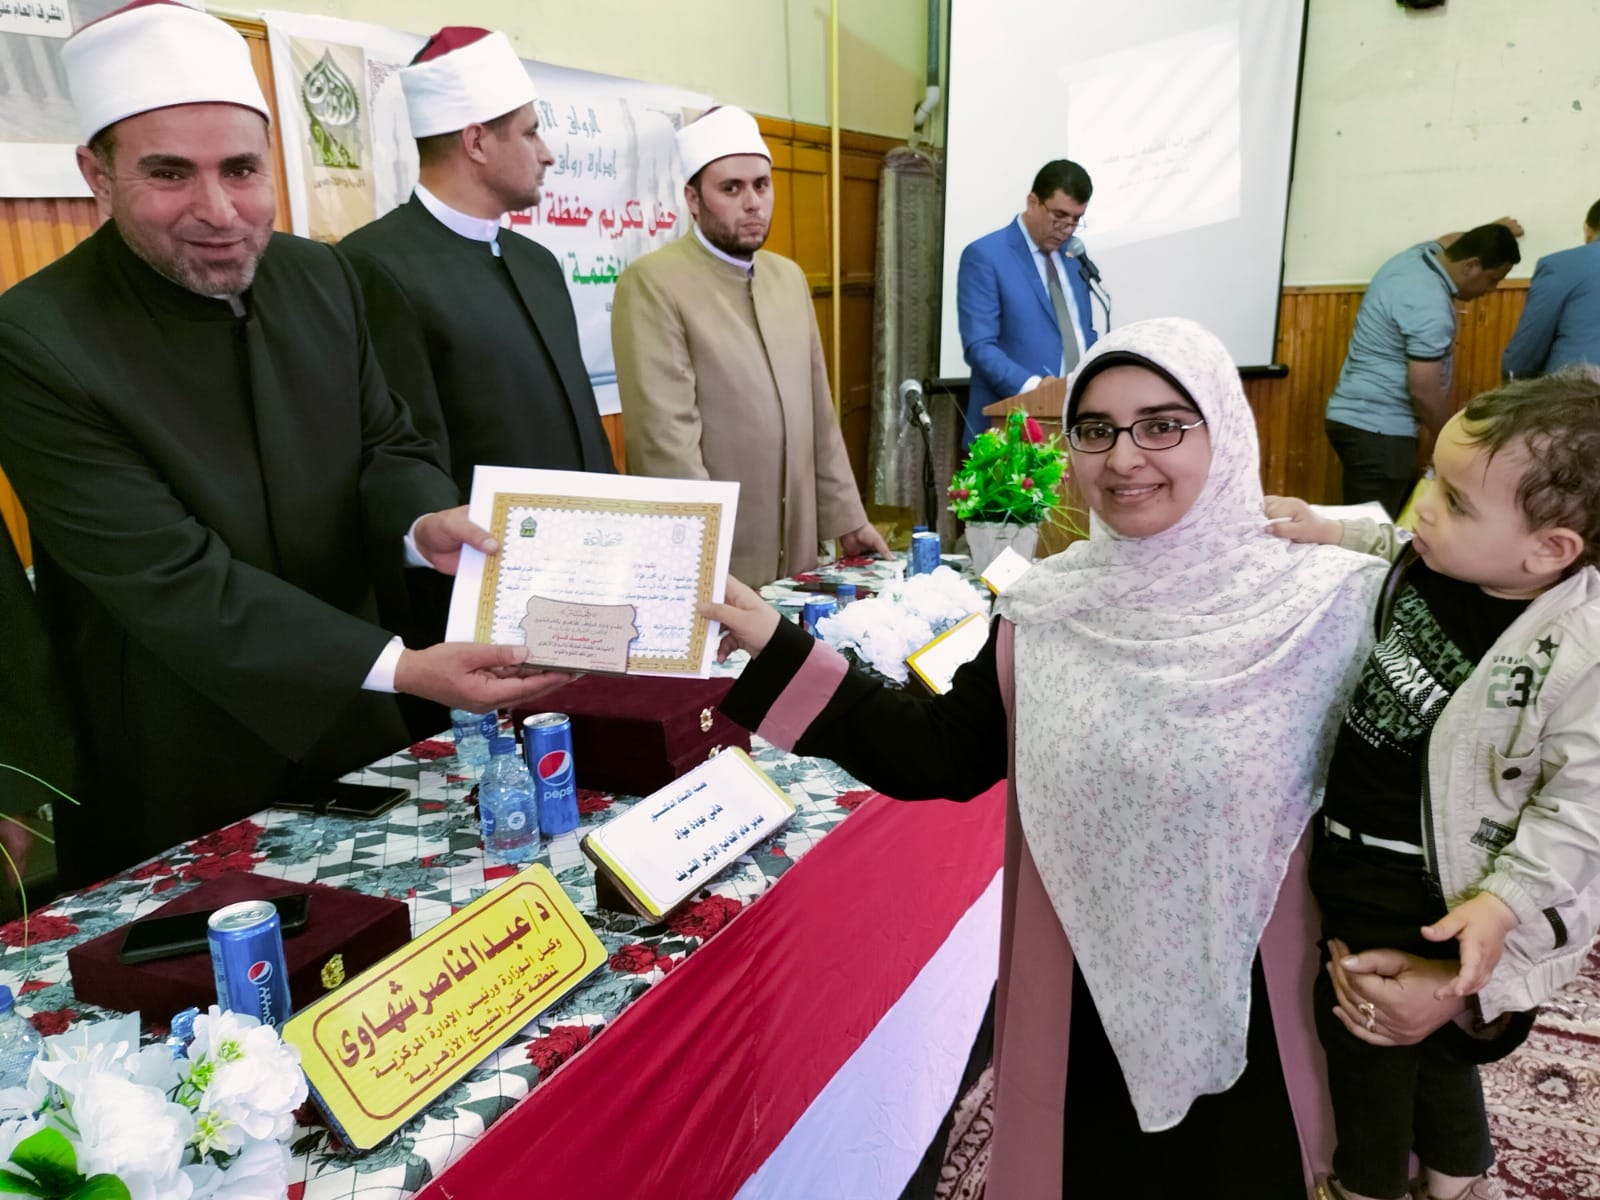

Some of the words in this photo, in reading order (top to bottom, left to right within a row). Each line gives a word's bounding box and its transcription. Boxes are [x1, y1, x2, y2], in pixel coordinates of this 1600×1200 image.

[545, 191, 593, 227] حفظة
[598, 199, 644, 239] تكريم
[648, 201, 678, 237] حفل
[543, 784, 574, 801] pepsi
[538, 937, 562, 963] وكيل
[499, 952, 534, 986] الوزارة
[526, 964, 559, 993] لمنطقة
[466, 982, 501, 1016] ورئيس
[428, 1009, 462, 1040] الإدارة
[370, 1034, 425, 1079] المركزية
